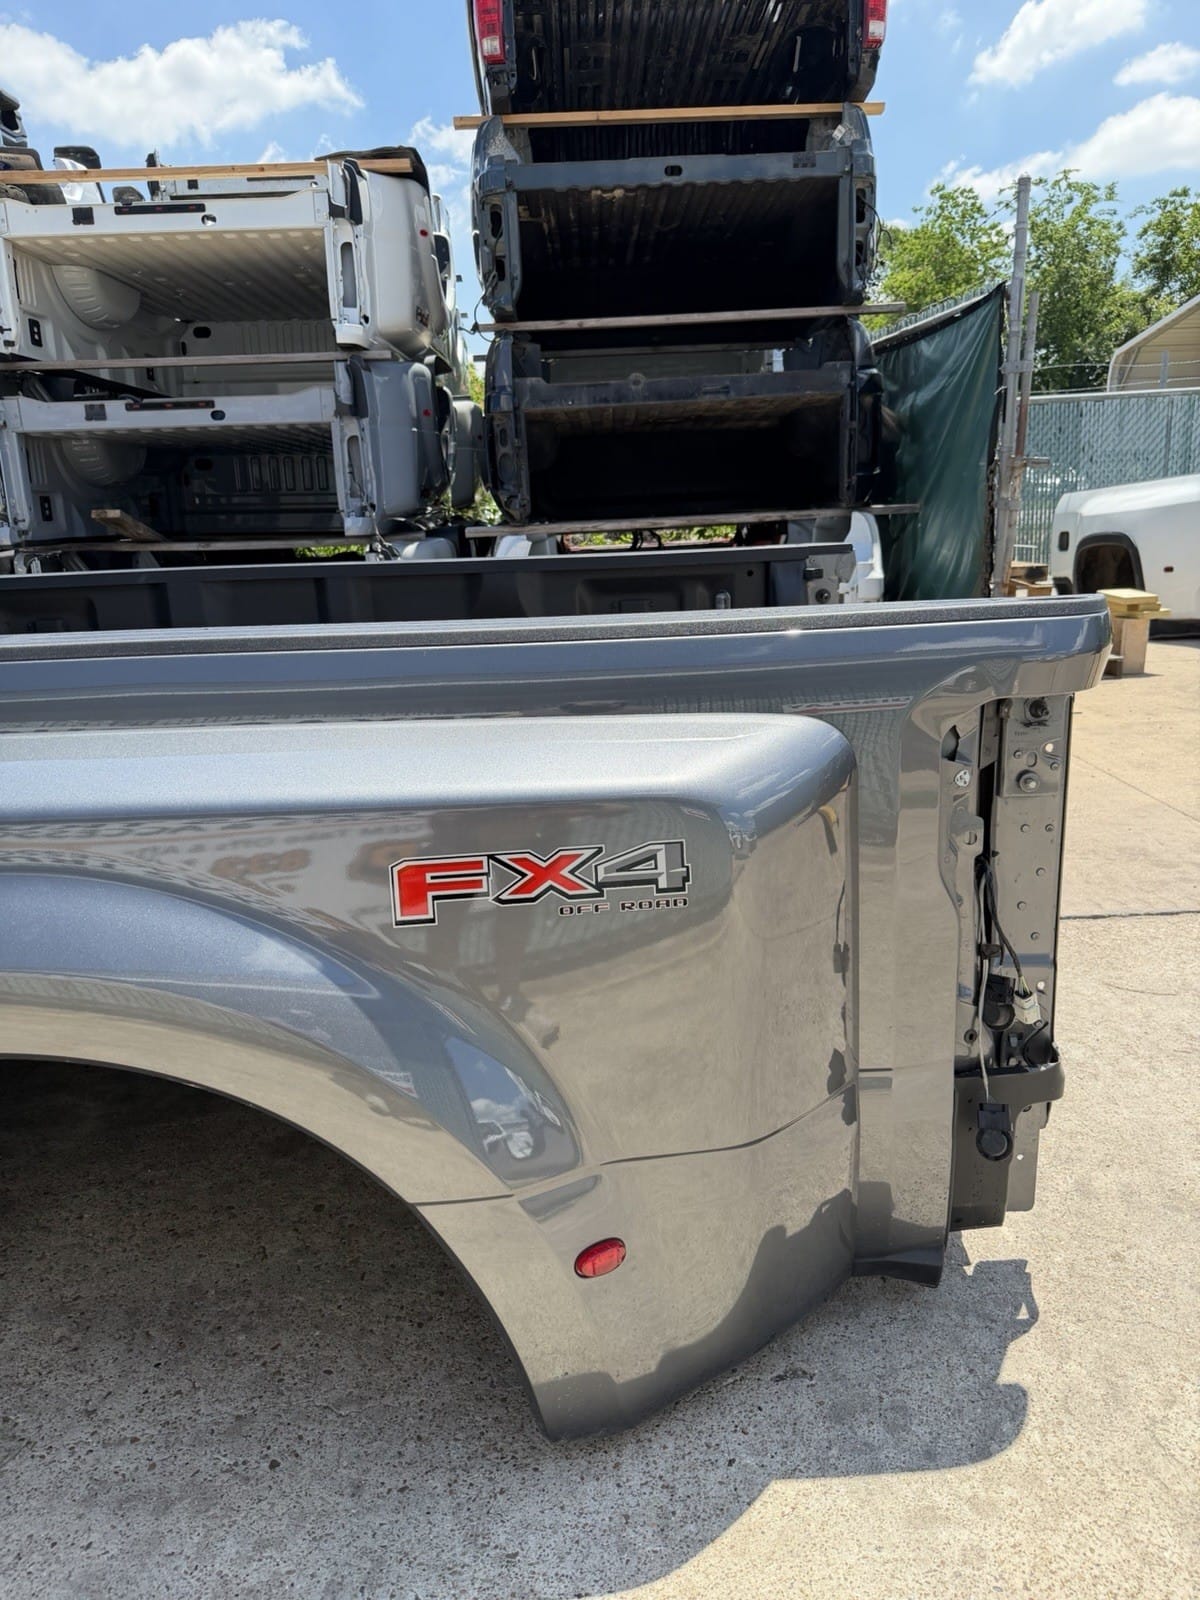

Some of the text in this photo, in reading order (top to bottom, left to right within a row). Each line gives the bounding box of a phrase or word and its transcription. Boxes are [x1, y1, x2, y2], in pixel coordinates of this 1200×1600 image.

[388, 839, 691, 928] FX4
[558, 897, 689, 916] OFF ROAD
